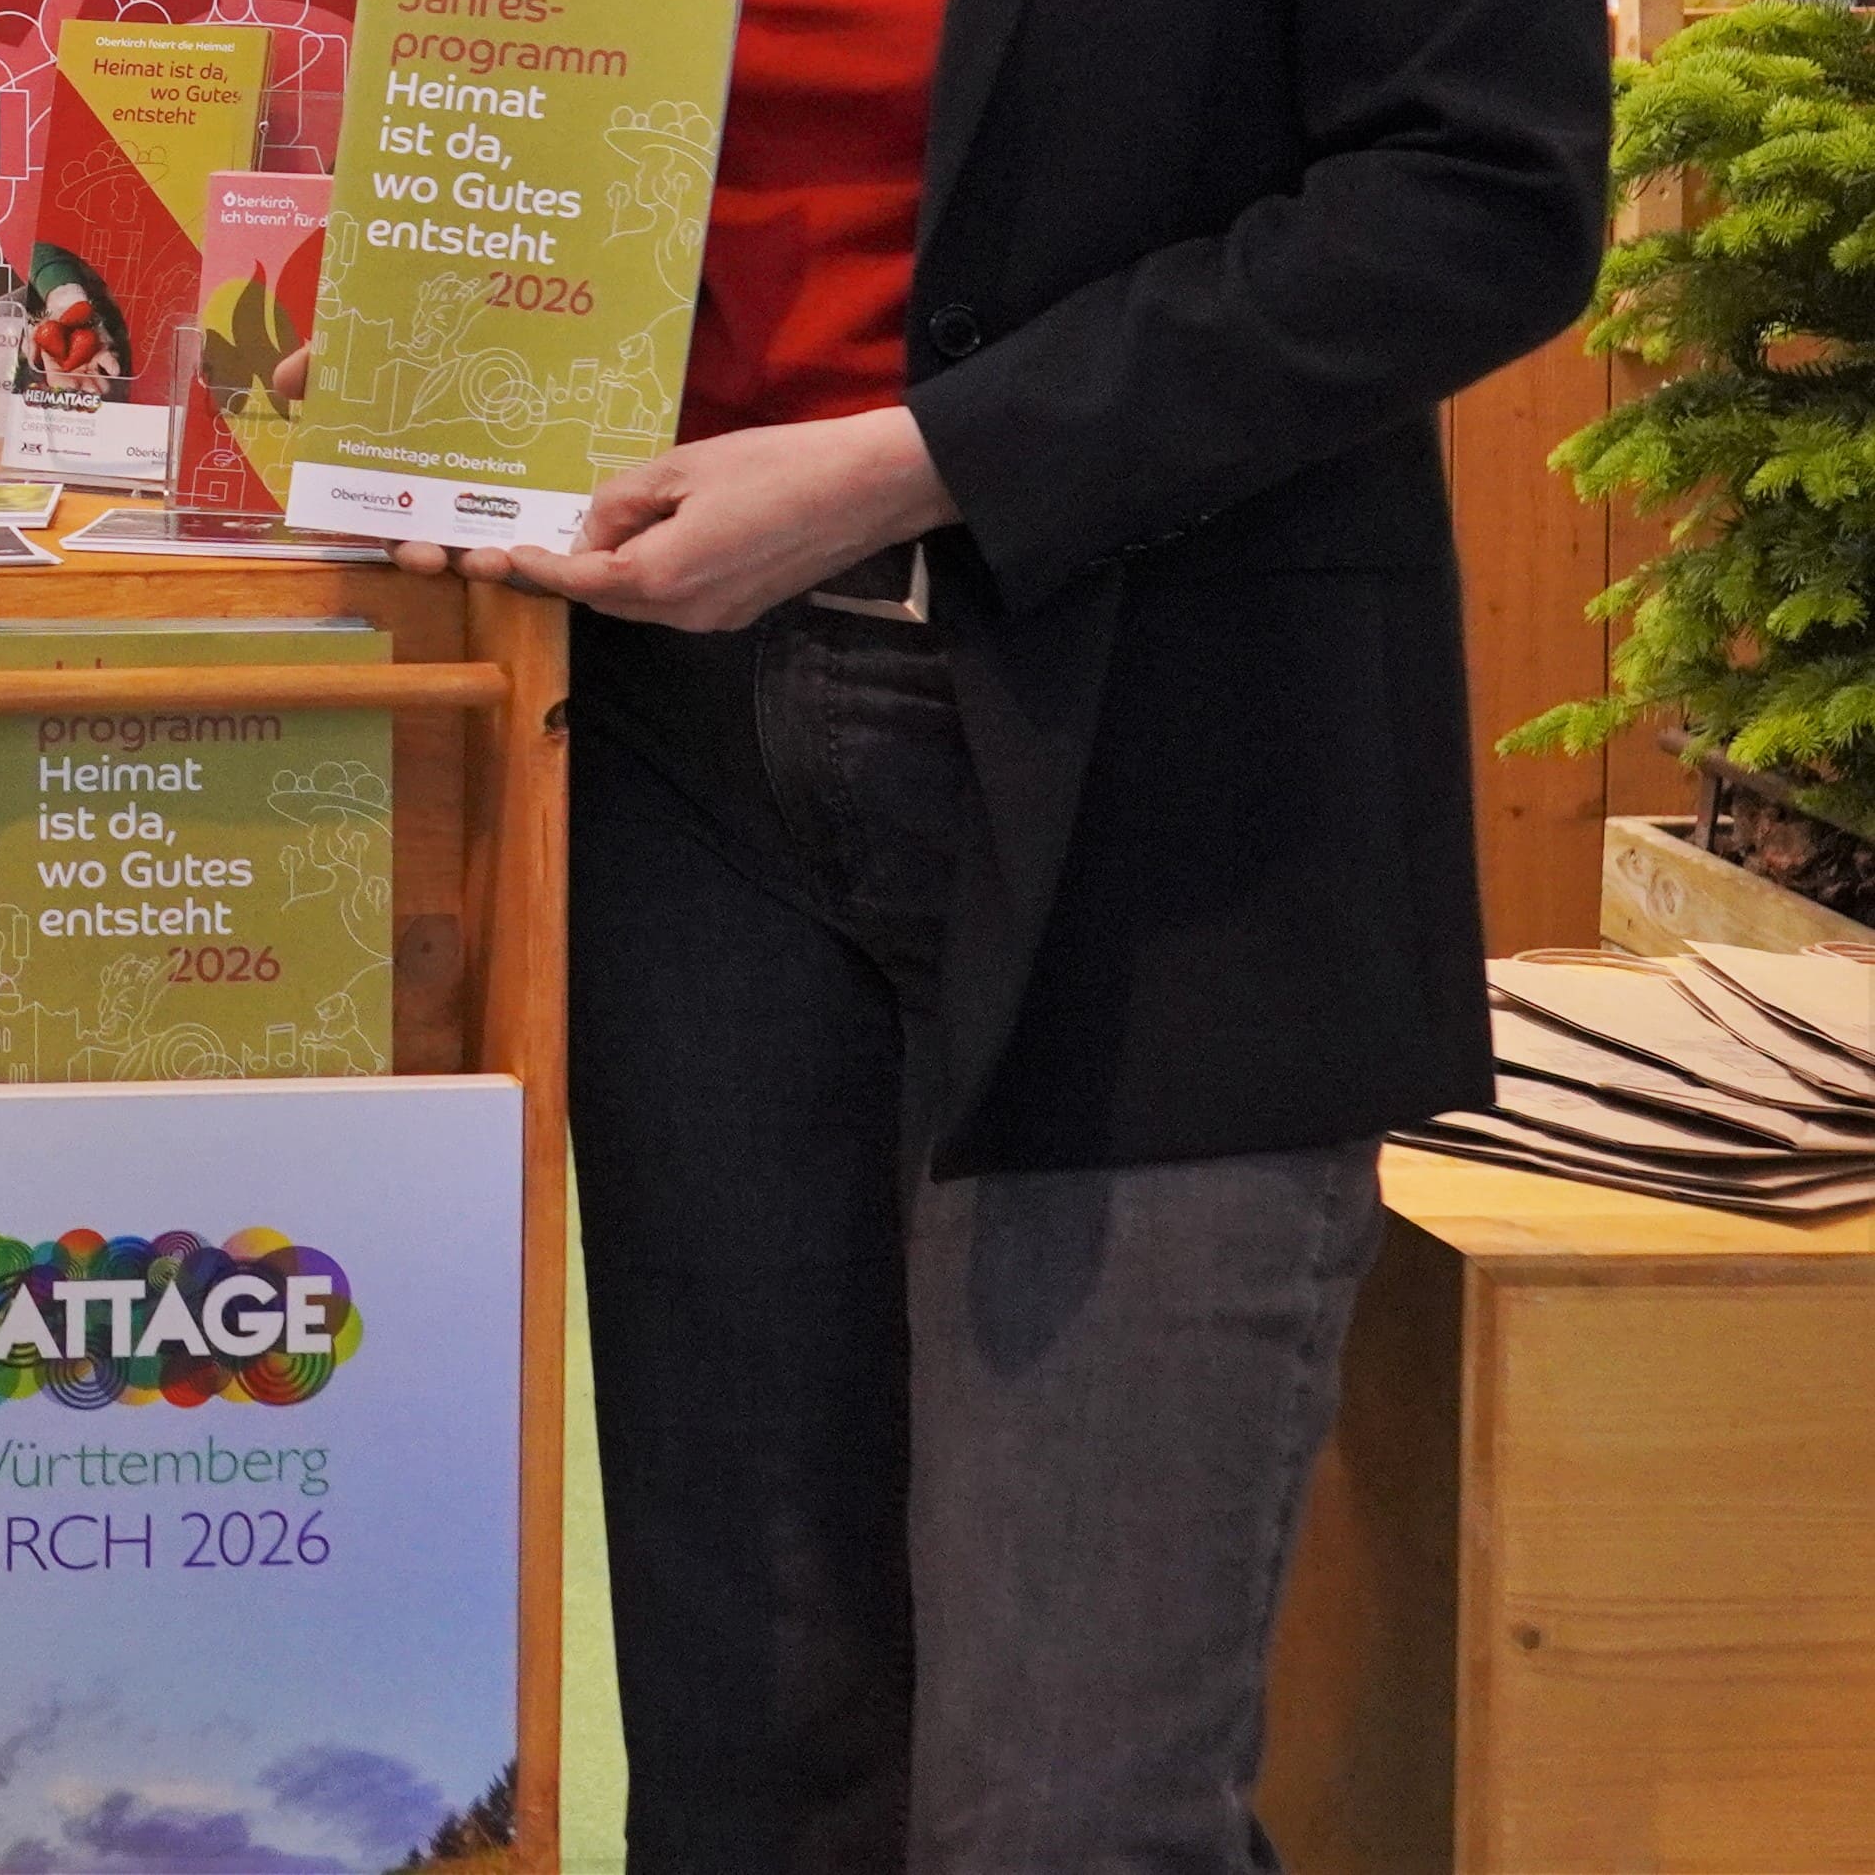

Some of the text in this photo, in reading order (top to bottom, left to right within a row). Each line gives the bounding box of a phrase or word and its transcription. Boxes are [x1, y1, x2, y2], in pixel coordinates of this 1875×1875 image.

[95, 36, 146, 49] Oberkirch
[177, 39, 194, 51] die
[389, 30, 628, 78] programm
[93, 57, 228, 84] Heimat ist da,
[150, 84, 242, 105] wo Gutes
[385, 71, 547, 120] Heimat
[112, 106, 197, 125] entsteht
[378, 117, 513, 170] ist da,
[223, 190, 299, 212] Oberkirch,
[372, 171, 583, 221] wo Gutes
[220, 209, 241, 224] ich
[293, 212, 316, 227] für
[366, 219, 557, 265] entsteht
[485, 271, 596, 316] 2026
[24, 389, 101, 409] HEIMATTAGE
[125, 445, 167, 459] Oberkir
[337, 439, 528, 476] Heimattage Oberkirch
[331, 487, 396, 507] Oberkirch
[37, 712, 282, 753] programm
[37, 755, 203, 793] Heimat
[37, 802, 177, 847] ist da,
[37, 849, 254, 889] wo Gutes
[37, 898, 233, 937] entsteht
[166, 946, 282, 984] 2026
[181, 1509, 331, 1570] 2026
